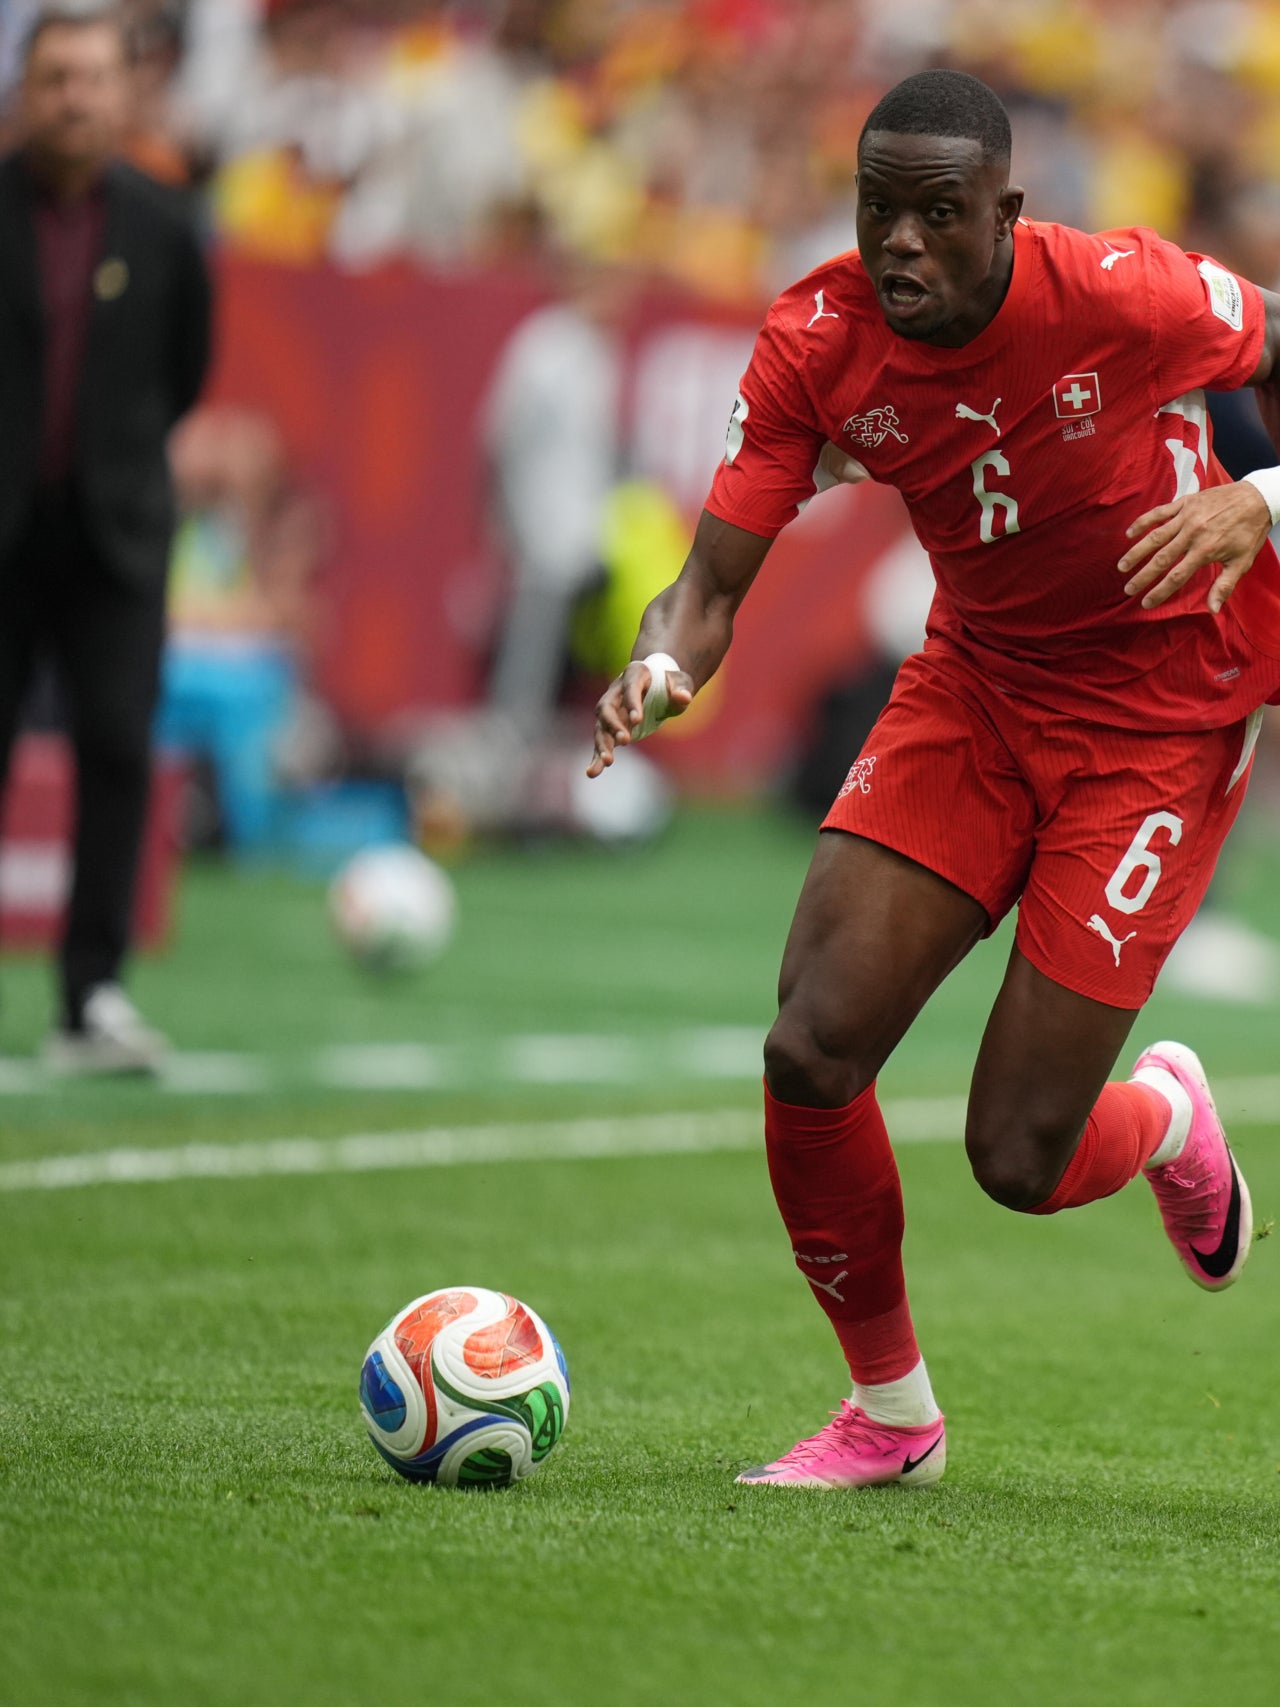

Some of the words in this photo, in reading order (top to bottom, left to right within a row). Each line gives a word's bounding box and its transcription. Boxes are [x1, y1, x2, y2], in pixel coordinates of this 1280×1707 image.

[1062, 424, 1074, 435] SUI
[1080, 416, 1095, 430] COL
[1063, 428, 1096, 442] VANCOUVER
[971, 449, 1021, 544] 6
[1104, 810, 1184, 915] 6
